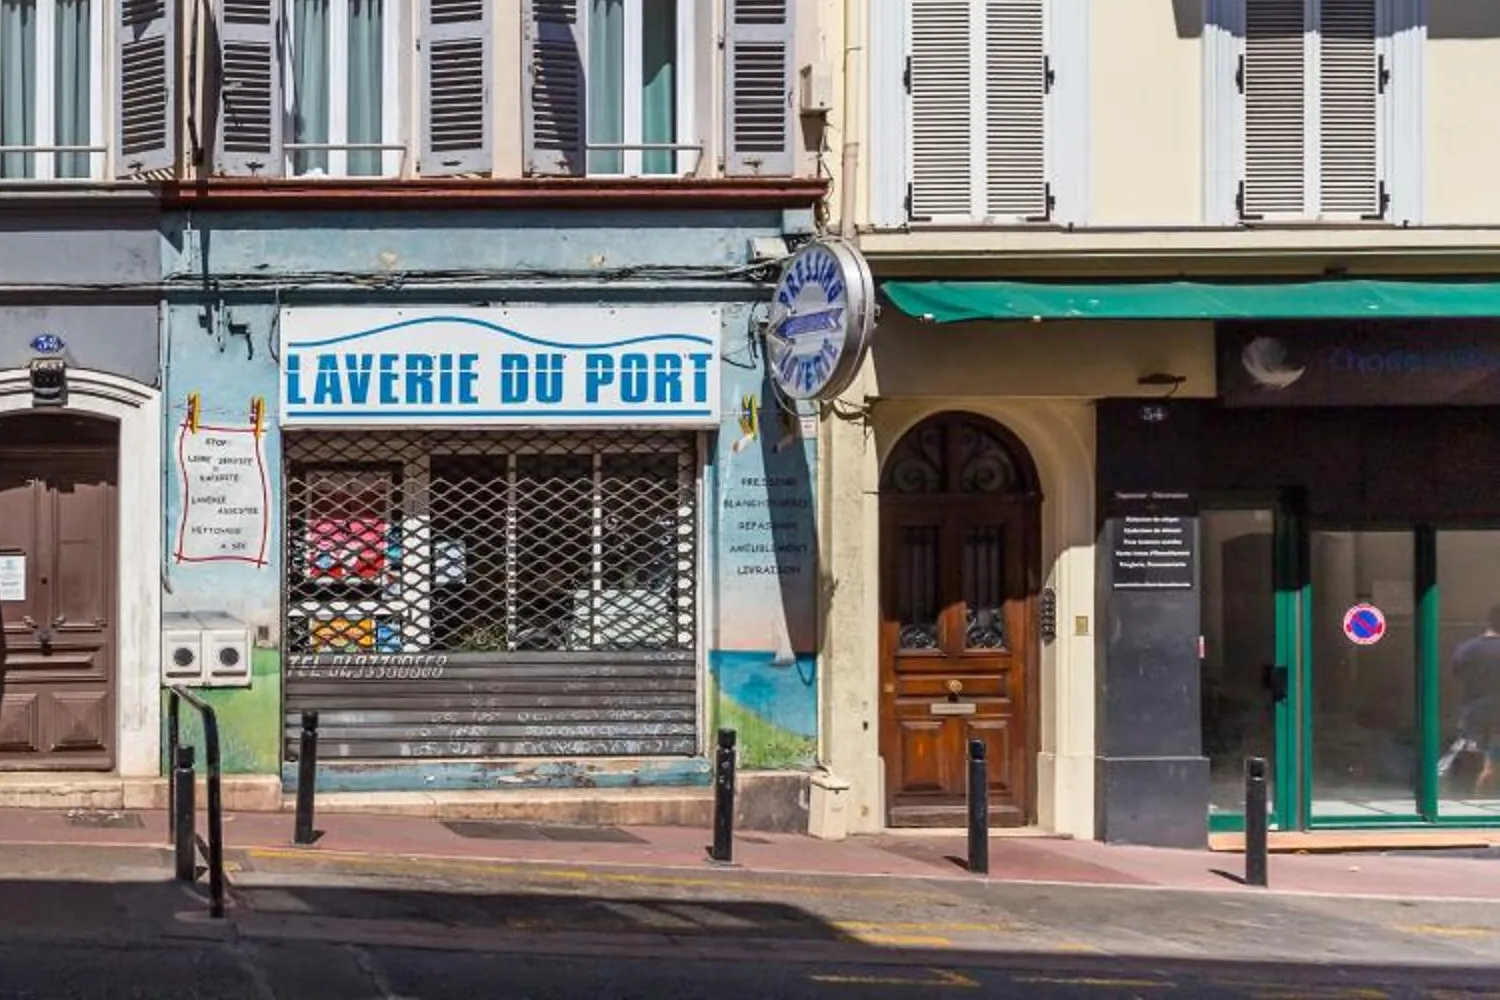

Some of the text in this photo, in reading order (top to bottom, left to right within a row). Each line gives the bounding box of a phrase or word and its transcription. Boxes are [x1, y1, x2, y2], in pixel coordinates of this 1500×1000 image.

[778, 250, 844, 308] PRESSING
[285, 353, 713, 404] LAVERIE DU PORT
